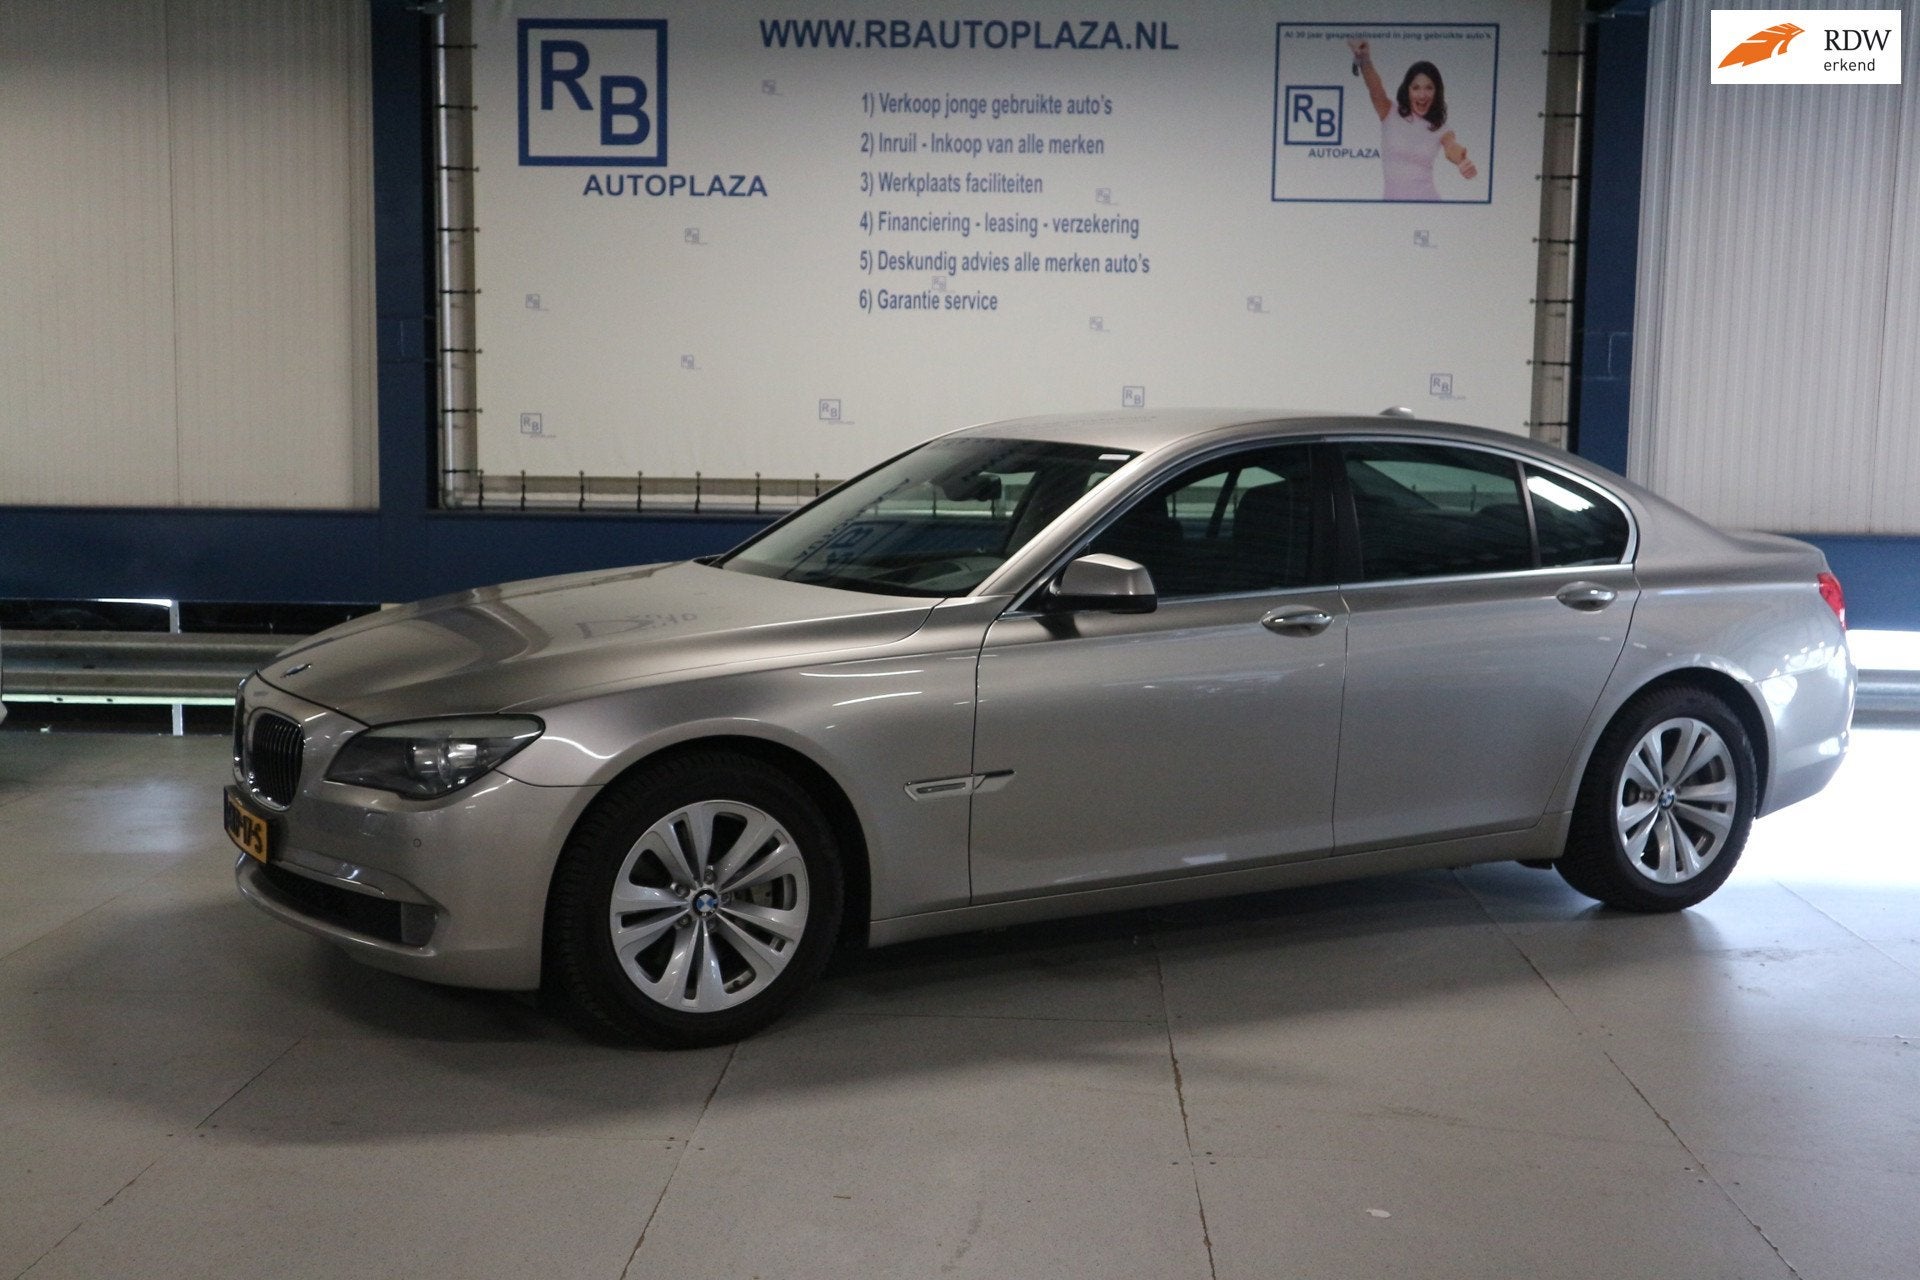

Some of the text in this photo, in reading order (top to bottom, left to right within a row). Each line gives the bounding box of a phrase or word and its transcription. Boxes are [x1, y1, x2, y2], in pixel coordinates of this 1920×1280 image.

[759, 19, 1179, 50] WWW.RBAUTOPLAZA.NL
[540, 40, 651, 146] RB
[862, 93, 1113, 119] 1) Verkoop jonge gebruikte auto's
[1293, 94, 1336, 137] RB
[860, 132, 875, 158] 2)
[878, 133, 918, 154] Inruil
[931, 134, 982, 158] Inkoop
[987, 139, 1013, 154] van
[1018, 134, 1044, 154] alle
[1049, 135, 1104, 154] merken
[1308, 148, 1380, 159] AUTOPLAZA
[583, 174, 768, 198] AUTOPLAZA
[860, 171, 1043, 197] 3) Werkplaats faciliteiten
[859, 211, 874, 236] 4)
[878, 211, 970, 237] Financiering
[985, 212, 1038, 238] leasing
[1053, 214, 1140, 240] verzekering
[860, 250, 1151, 276] 5) Deskundig advies alle merken auto's
[859, 289, 998, 314] 6) Garantie service
